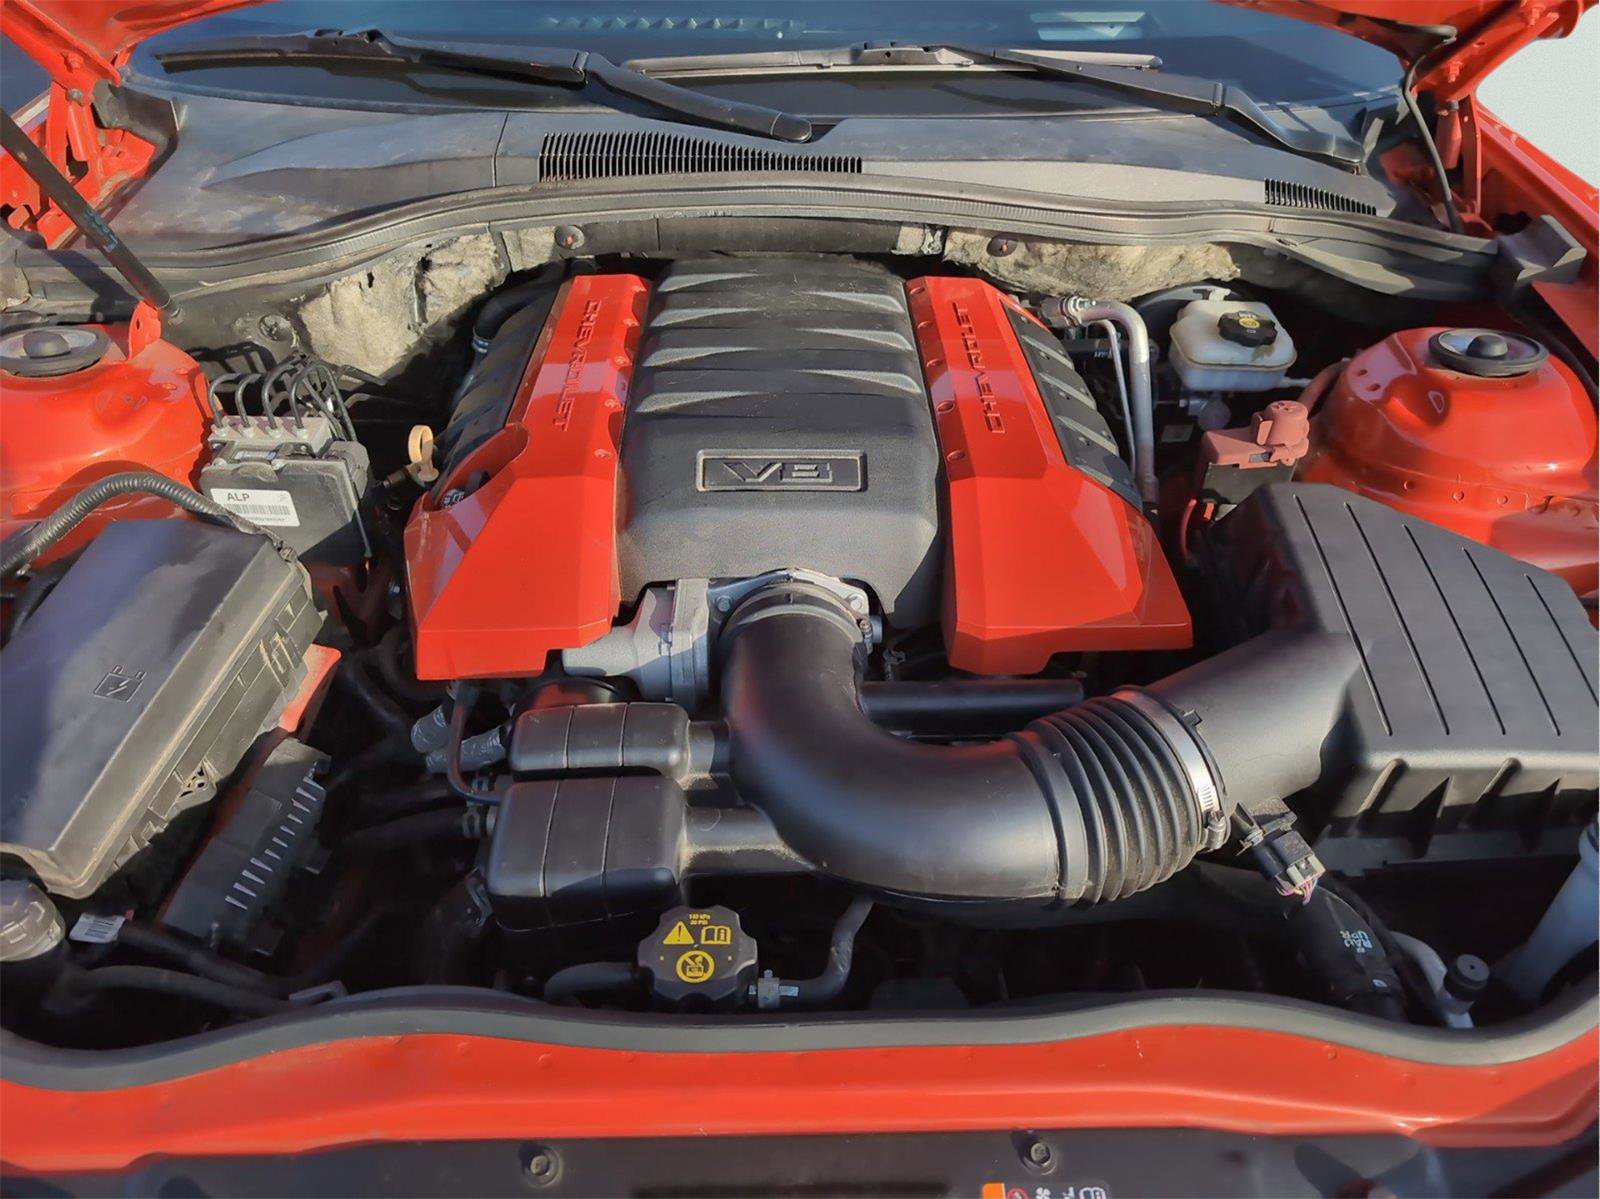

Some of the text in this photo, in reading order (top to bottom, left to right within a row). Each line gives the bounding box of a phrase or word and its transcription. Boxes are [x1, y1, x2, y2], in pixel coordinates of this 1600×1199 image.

[552, 299, 602, 432] CHEVROLET
[952, 302, 1006, 434] CHEVROLET
[226, 492, 250, 502] ALP
[722, 461, 833, 483] V8
